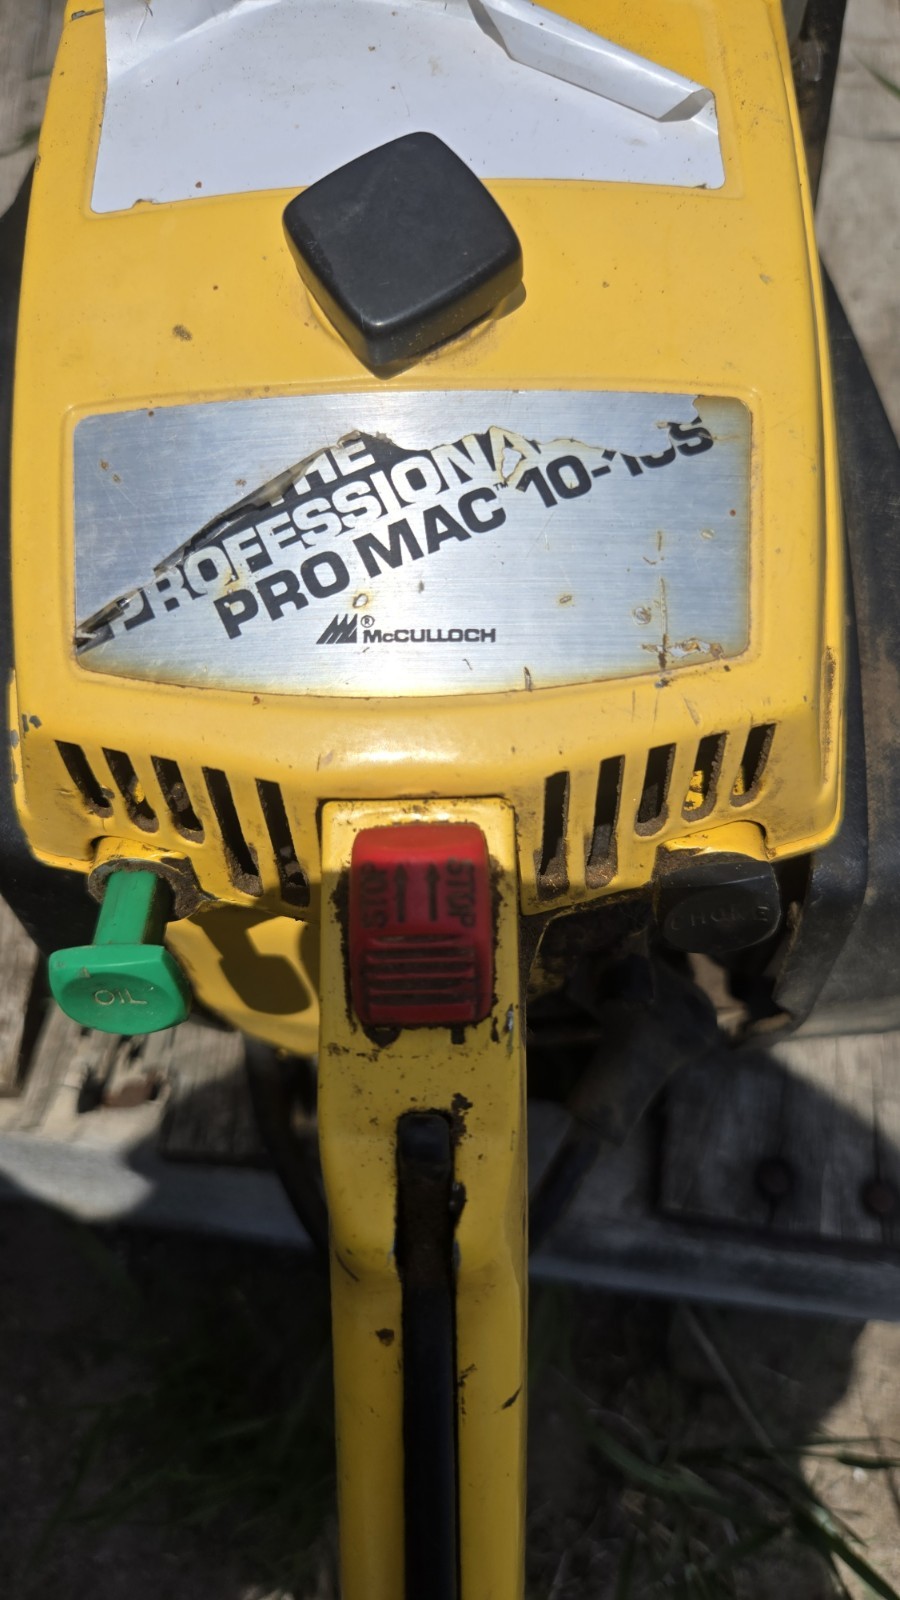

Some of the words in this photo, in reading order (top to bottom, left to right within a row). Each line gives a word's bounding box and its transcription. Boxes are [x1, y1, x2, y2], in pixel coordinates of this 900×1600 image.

[268, 437, 376, 508] HE
[212, 550, 351, 640] PRO
[353, 486, 507, 579] MAC
[362, 628, 497, 644] McCULLOCH
[361, 860, 389, 929] STOP
[446, 856, 477, 928] STOP
[94, 988, 149, 1006] OIL
